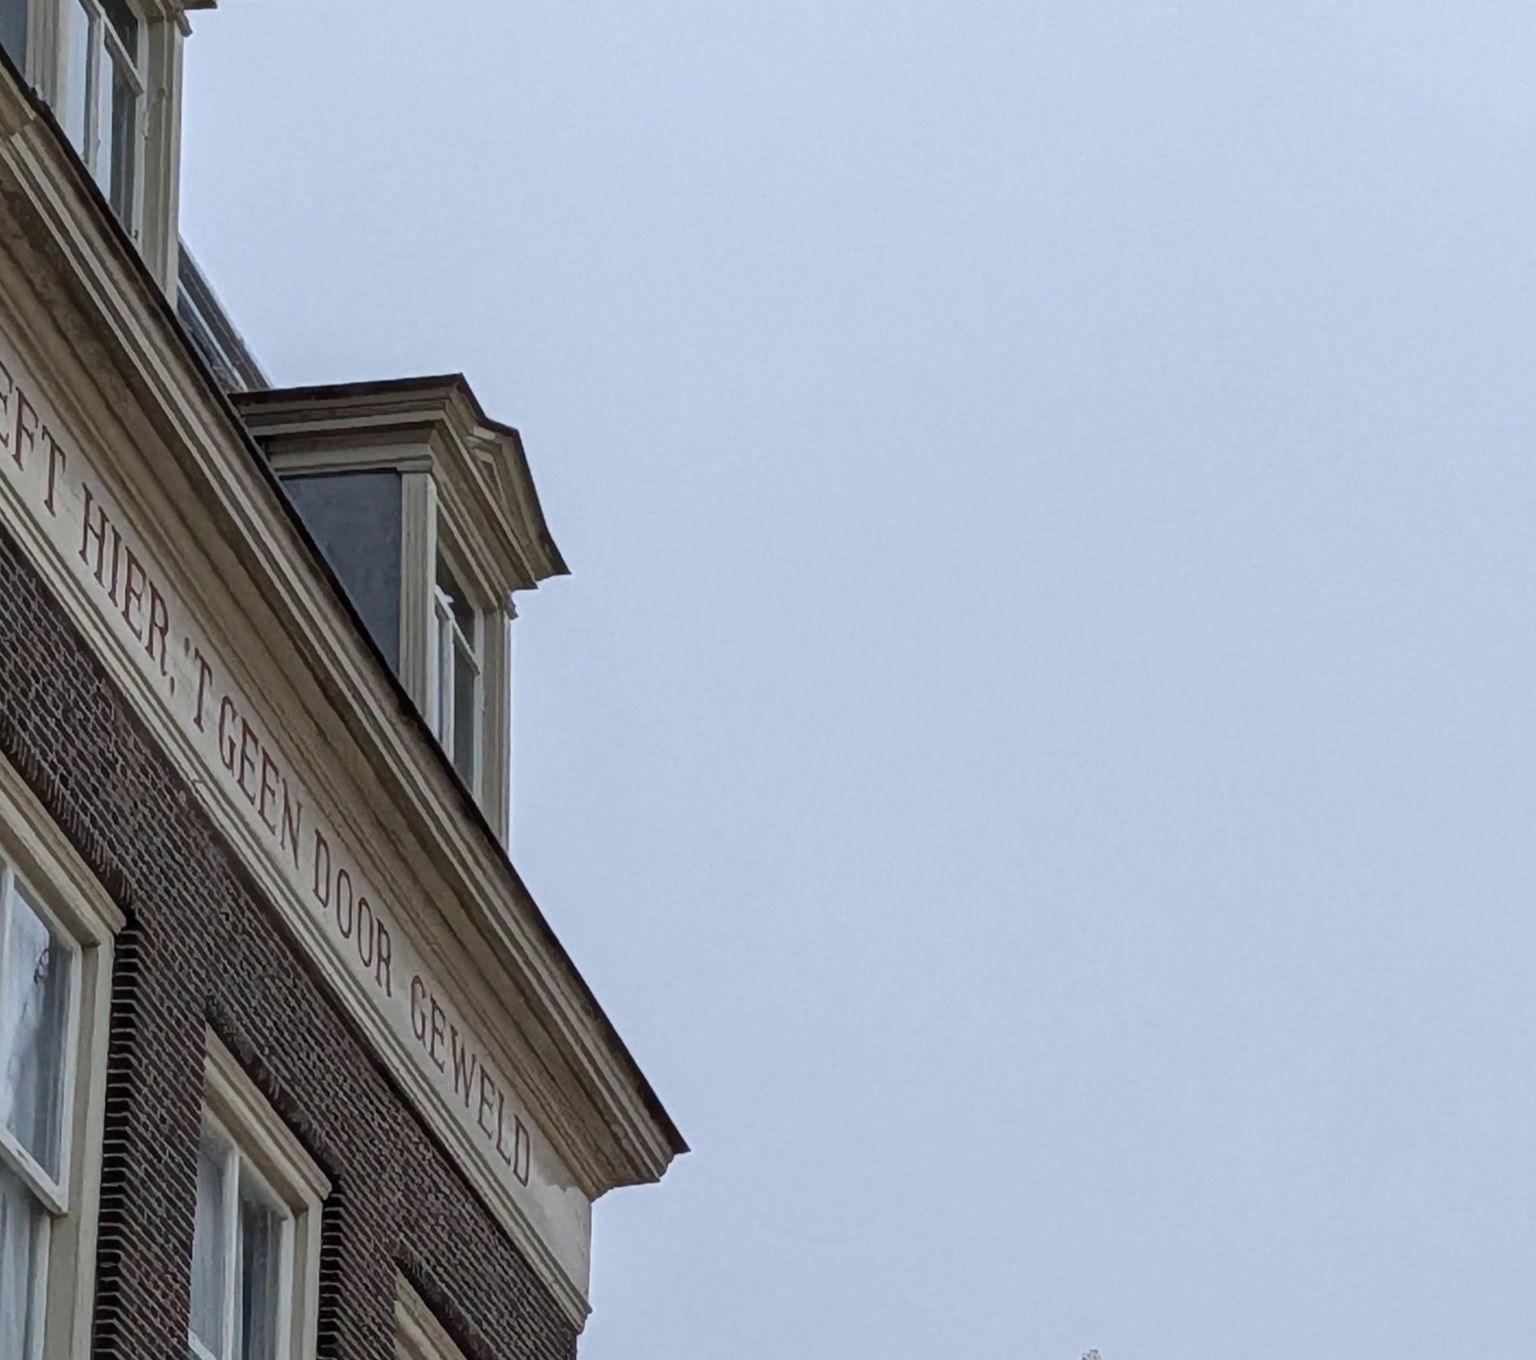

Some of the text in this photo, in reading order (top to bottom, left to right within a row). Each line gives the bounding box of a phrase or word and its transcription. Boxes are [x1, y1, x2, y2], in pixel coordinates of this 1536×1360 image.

[218, 695, 303, 870] GEEN
[313, 828, 392, 998] DOOR
[411, 974, 531, 1188] GEWELD
